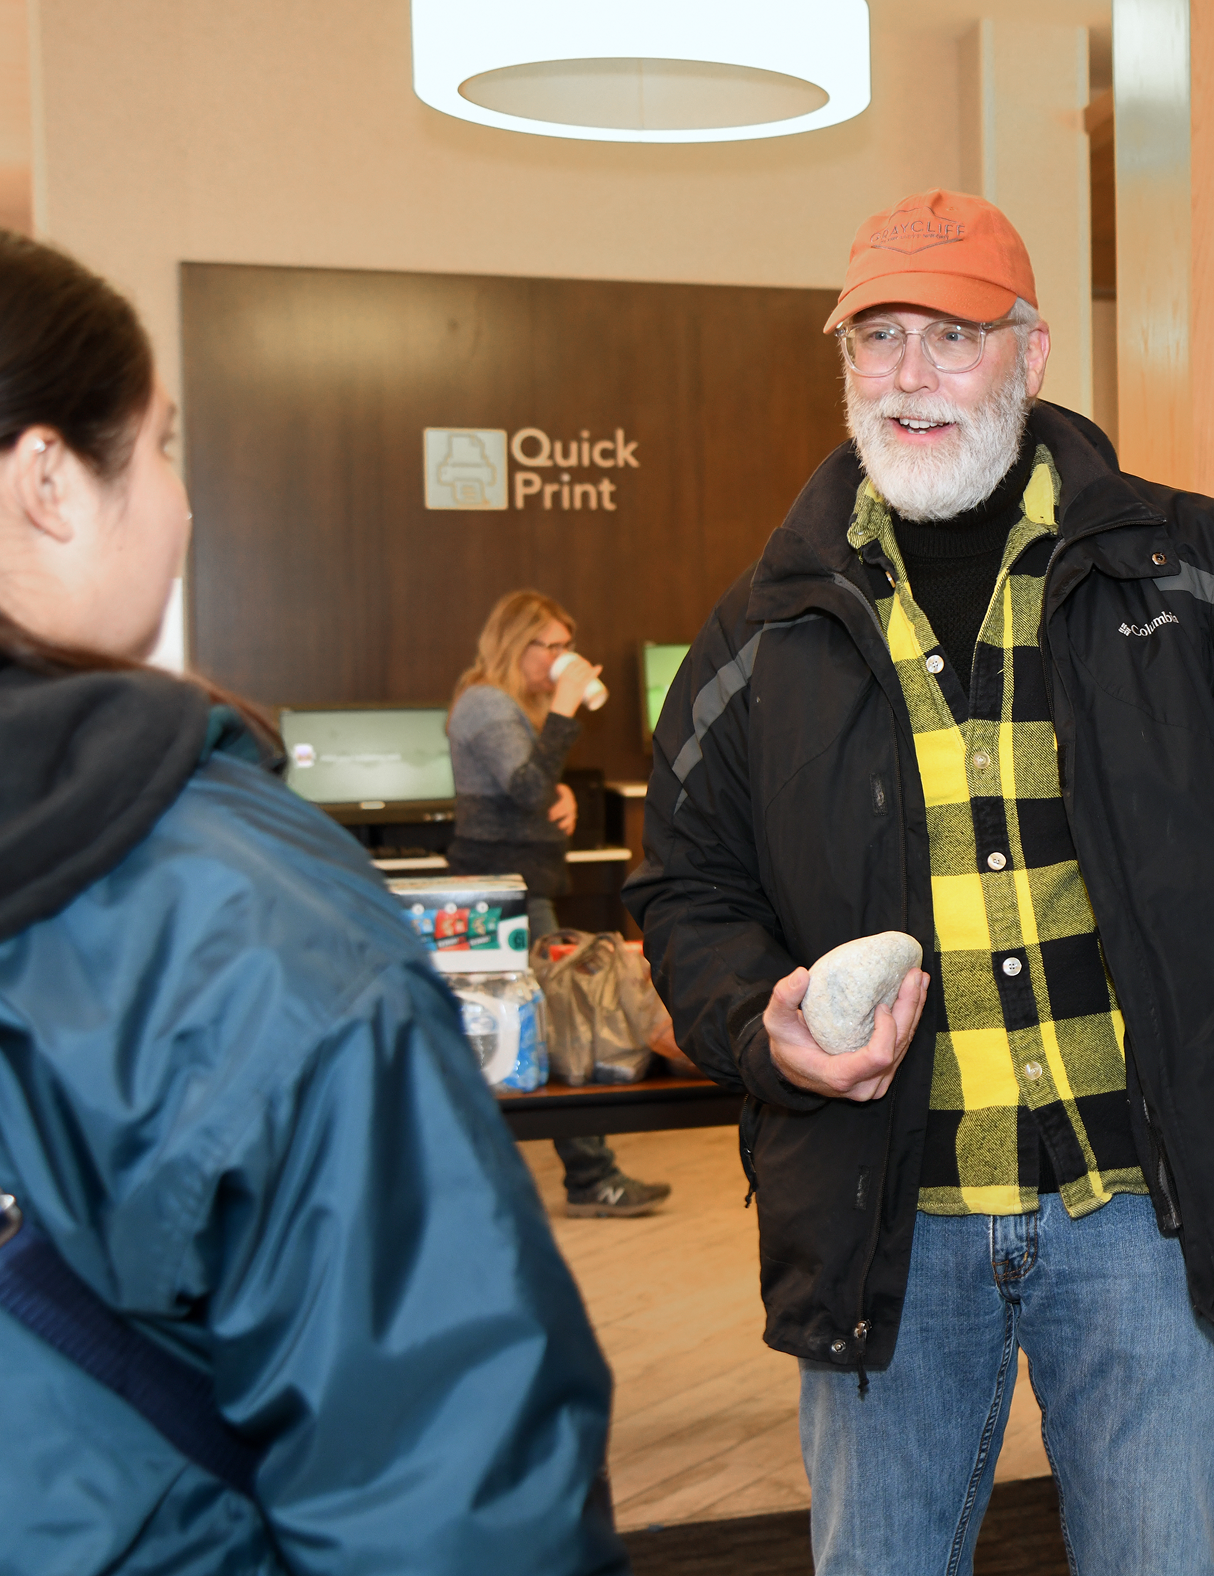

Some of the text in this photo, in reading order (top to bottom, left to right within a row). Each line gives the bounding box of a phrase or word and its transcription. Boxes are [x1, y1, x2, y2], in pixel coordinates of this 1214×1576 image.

[870, 220, 965, 243] GRAYCLIFF
[511, 427, 640, 468] Quick
[514, 471, 617, 511] Print
[1130, 611, 1179, 637] Columbia
